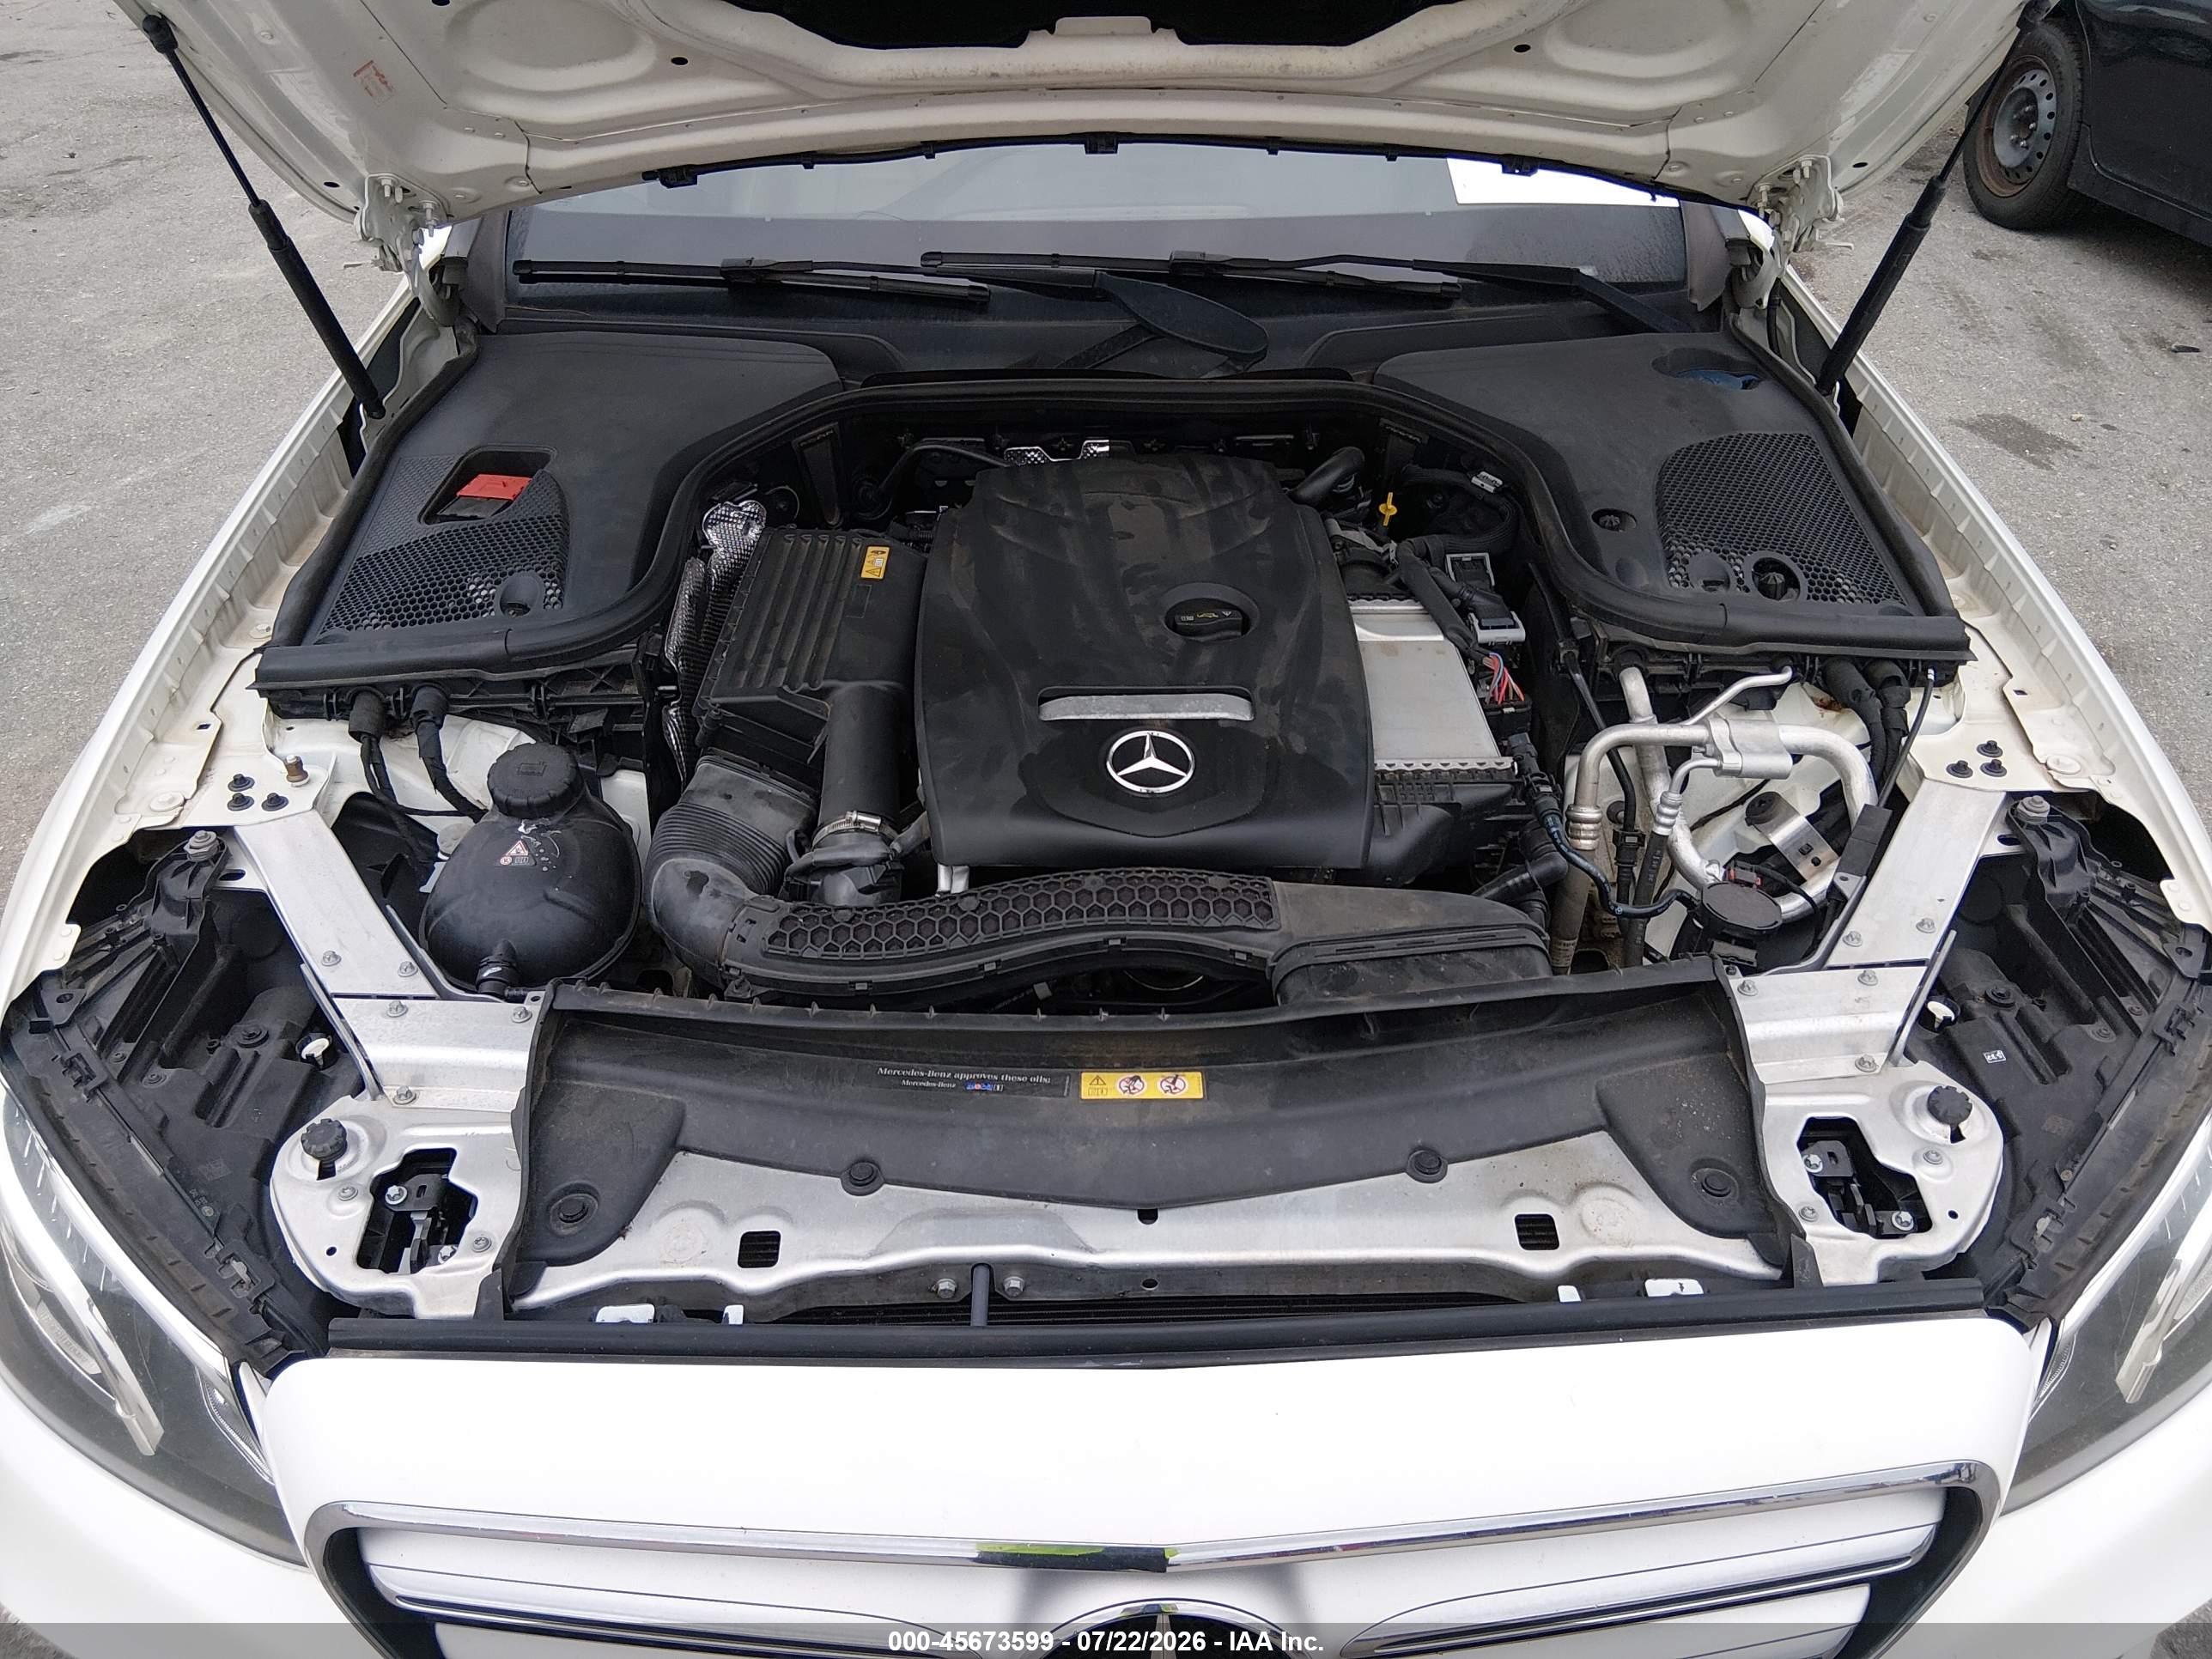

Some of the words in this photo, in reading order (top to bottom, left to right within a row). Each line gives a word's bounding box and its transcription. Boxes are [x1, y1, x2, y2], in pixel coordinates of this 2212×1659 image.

[877, 1067, 951, 1079] Mercedes-Benz
[953, 1072, 999, 1081] approves
[1000, 1073, 1028, 1082] these
[901, 1079, 957, 1089] Mercedes-Benz
